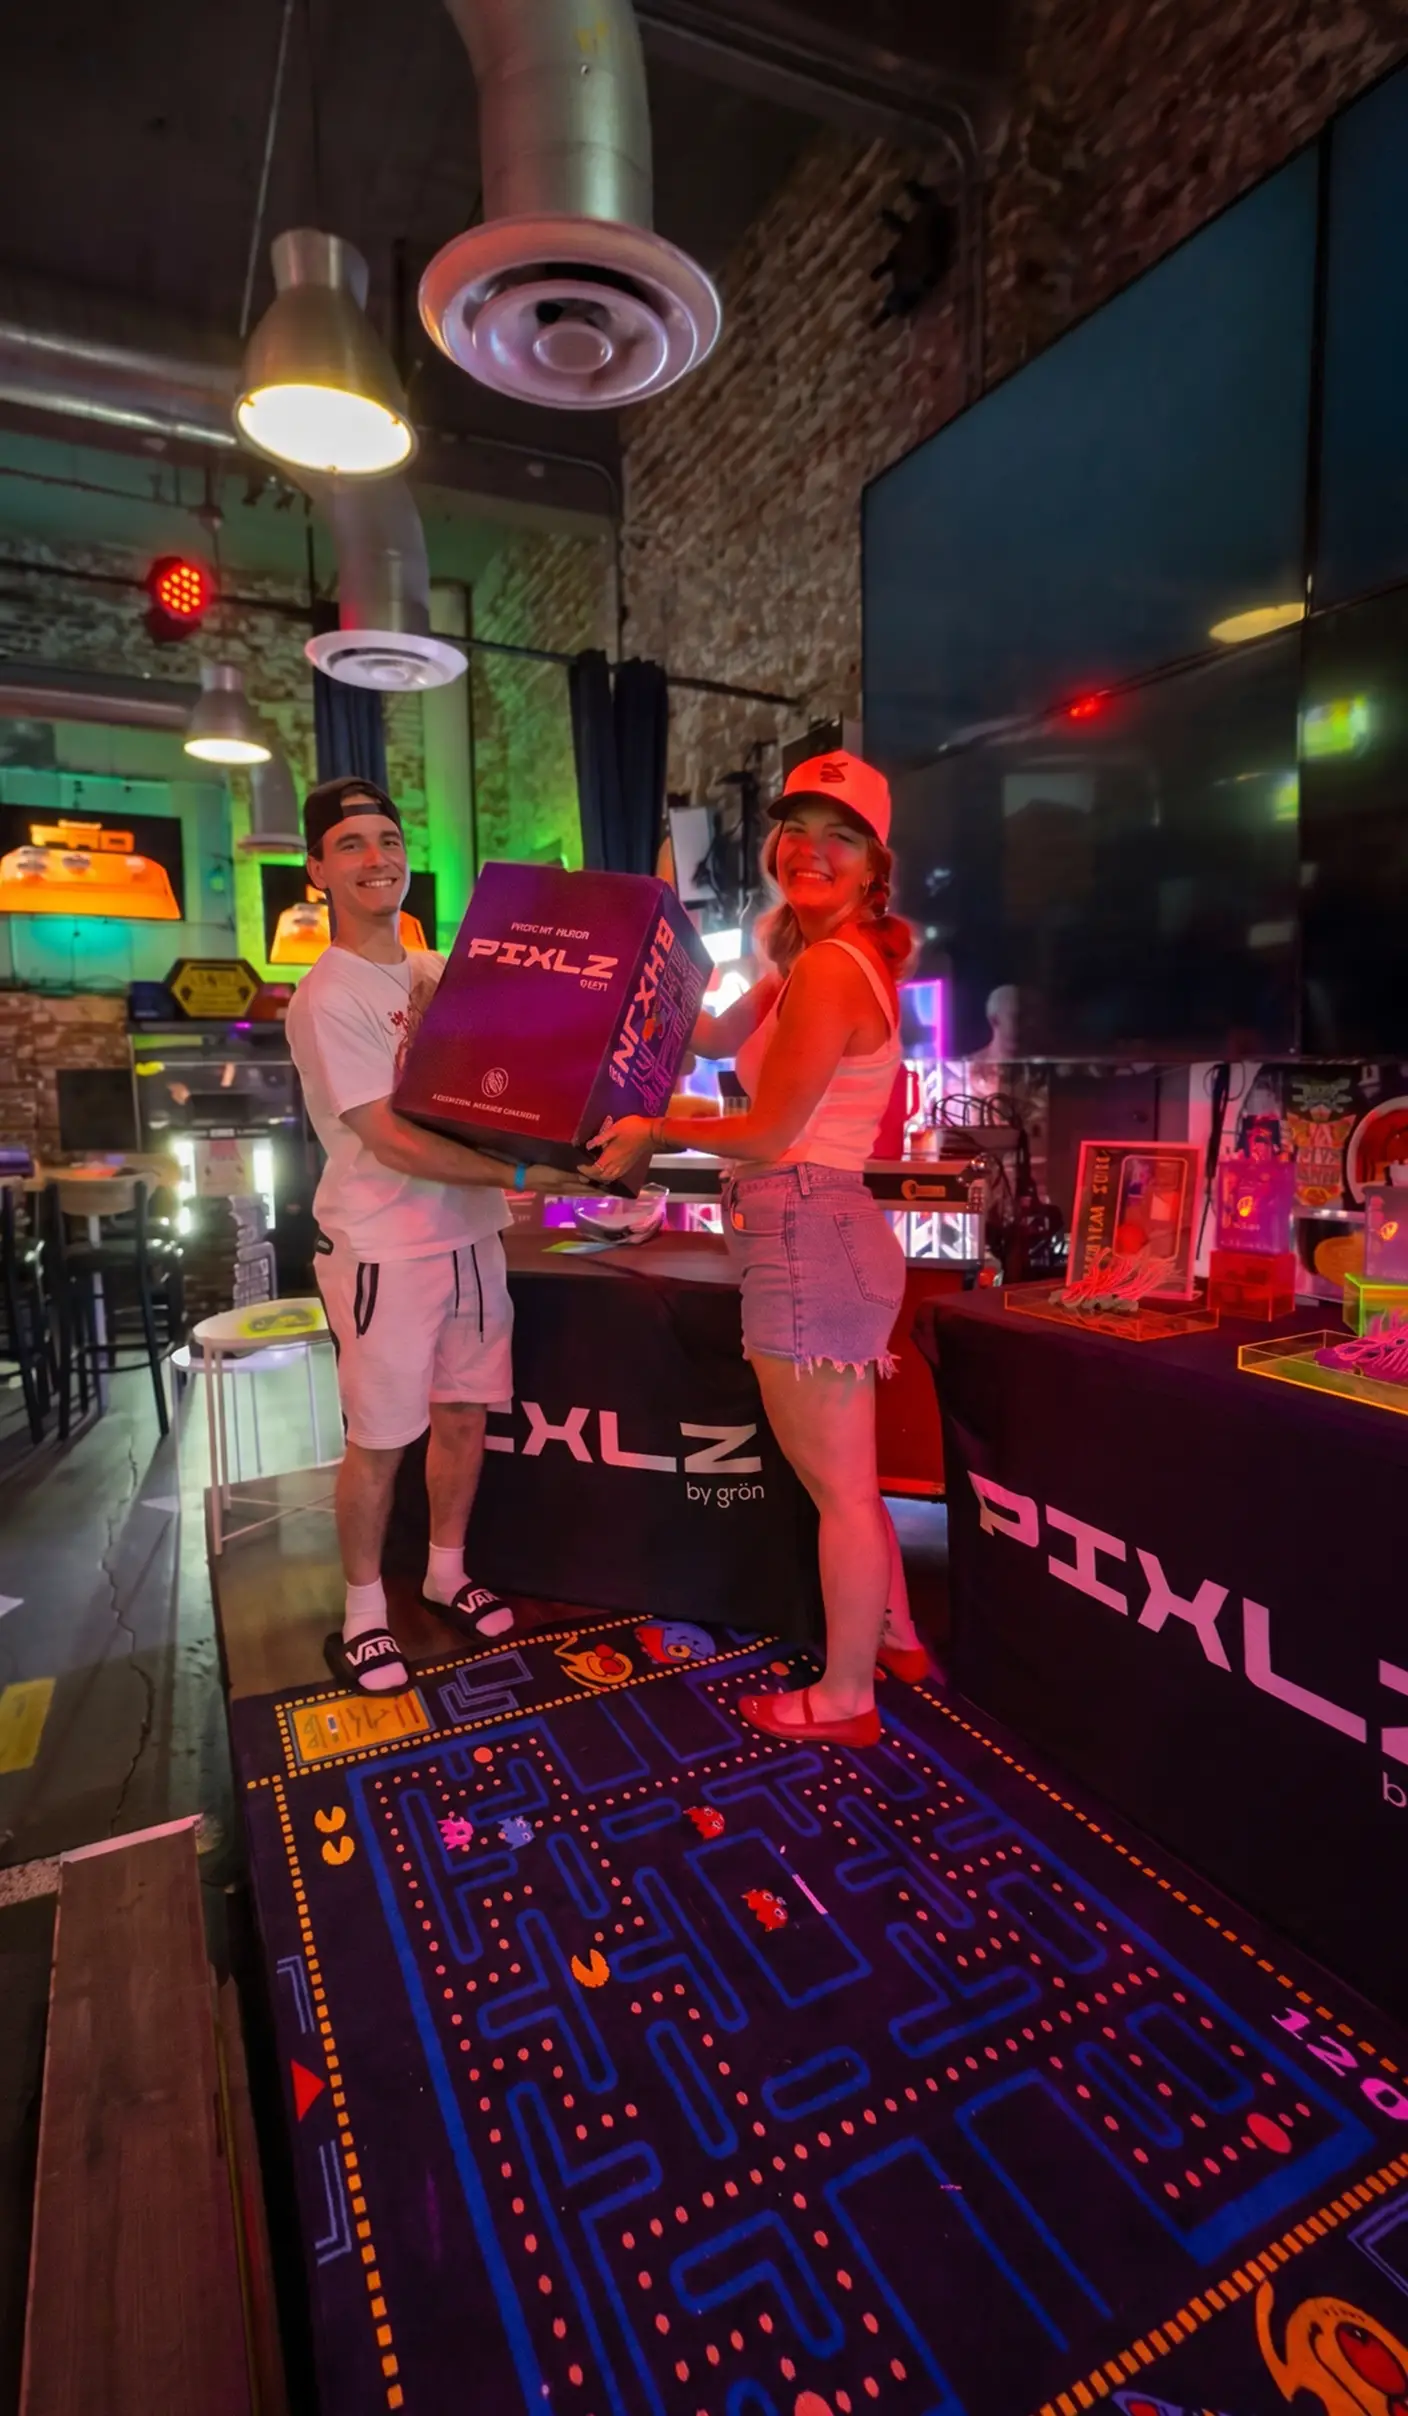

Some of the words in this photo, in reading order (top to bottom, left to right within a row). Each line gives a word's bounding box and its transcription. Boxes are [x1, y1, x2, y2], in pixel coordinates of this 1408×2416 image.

[468, 938, 618, 979] PIXLZ
[686, 1481, 711, 1505] by
[716, 1483, 765, 1508] grön
